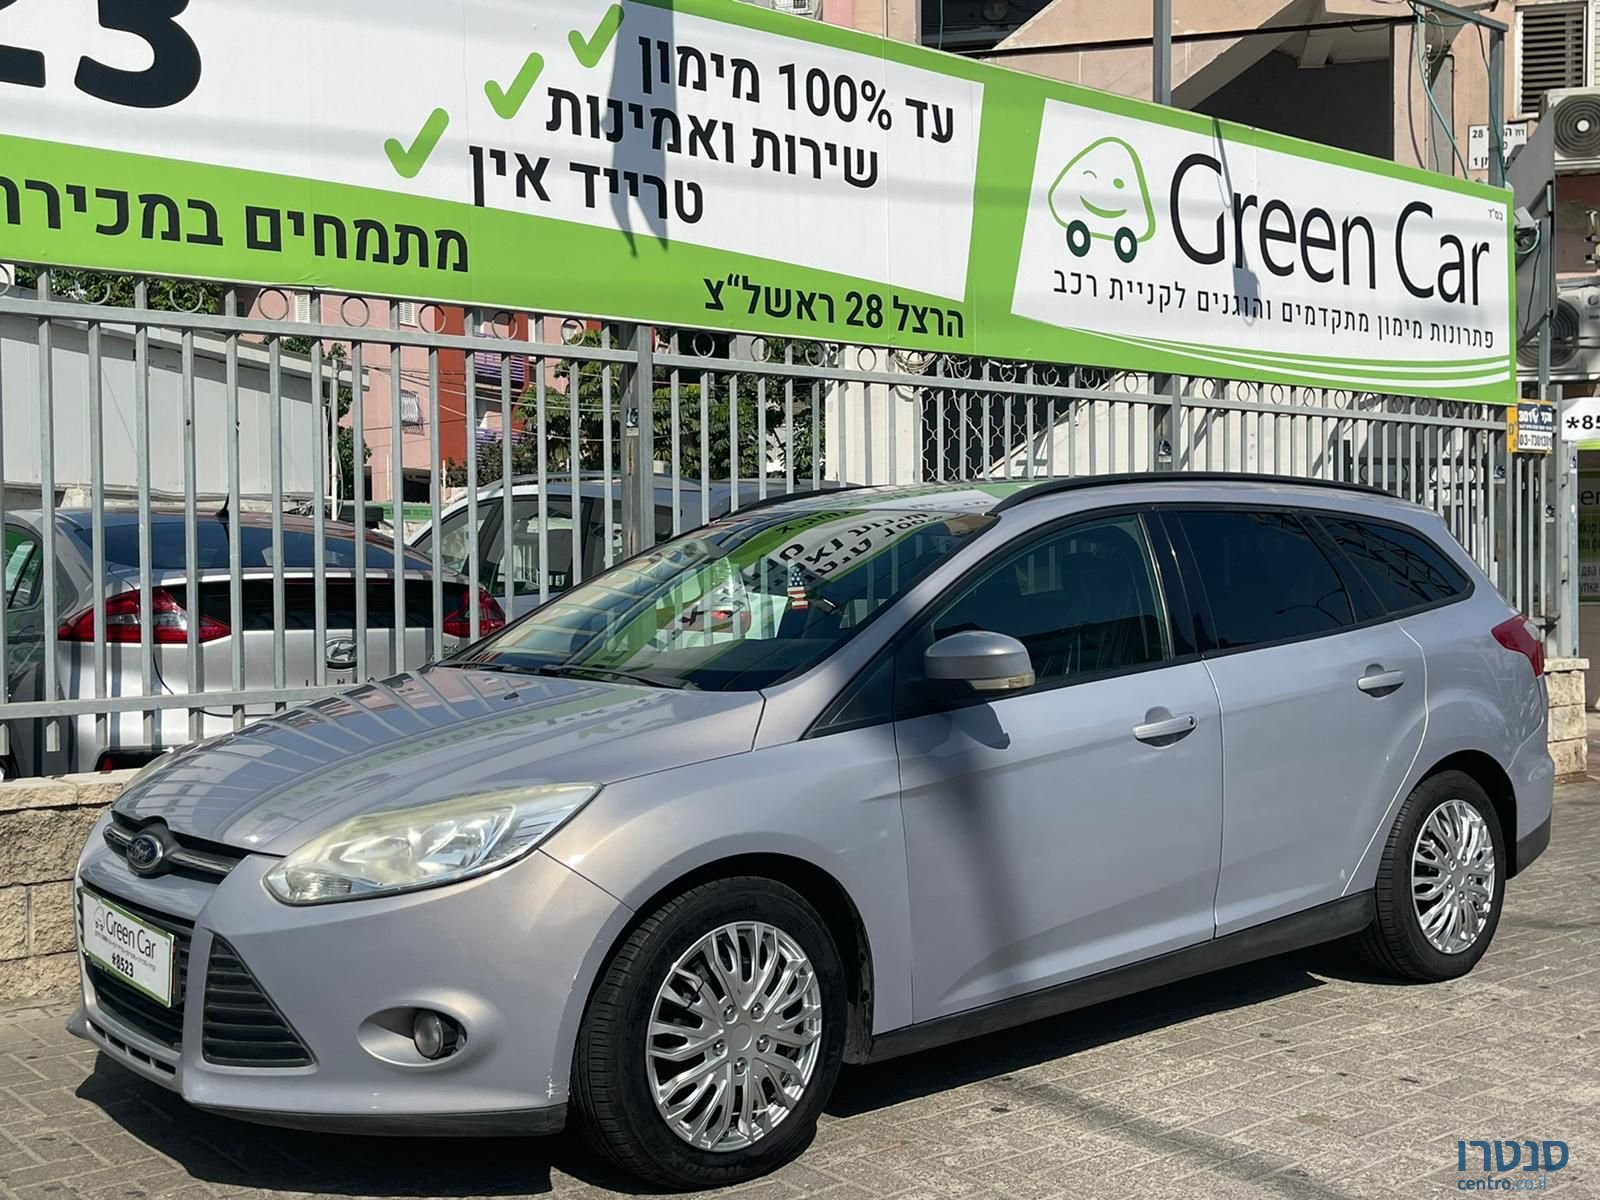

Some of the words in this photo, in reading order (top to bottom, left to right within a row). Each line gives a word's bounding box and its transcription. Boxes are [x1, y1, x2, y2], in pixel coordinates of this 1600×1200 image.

[638, 35, 760, 103] מימון
[778, 63, 893, 131] 100%
[904, 97, 954, 143] עד
[546, 87, 734, 165] ואמינות
[1472, 129, 1484, 138] 28
[469, 145, 552, 208] אין
[751, 127, 879, 188] שירות
[569, 162, 704, 224] טרייד
[245, 205, 469, 273] מתמחים
[1170, 153, 1376, 290] Green
[1395, 200, 1490, 306] Car
[1053, 269, 1097, 297] רכב
[1109, 277, 1187, 313] לקניית
[1197, 290, 1272, 321] והוגנים
[845, 291, 884, 329] 28
[893, 295, 964, 340] הרצל
[1281, 302, 1370, 335] מתקדמים
[1377, 315, 1423, 341] מימון
[1430, 322, 1494, 349] פתרונות
[105, 911, 135, 949] Green
[136, 928, 157, 960] Car
